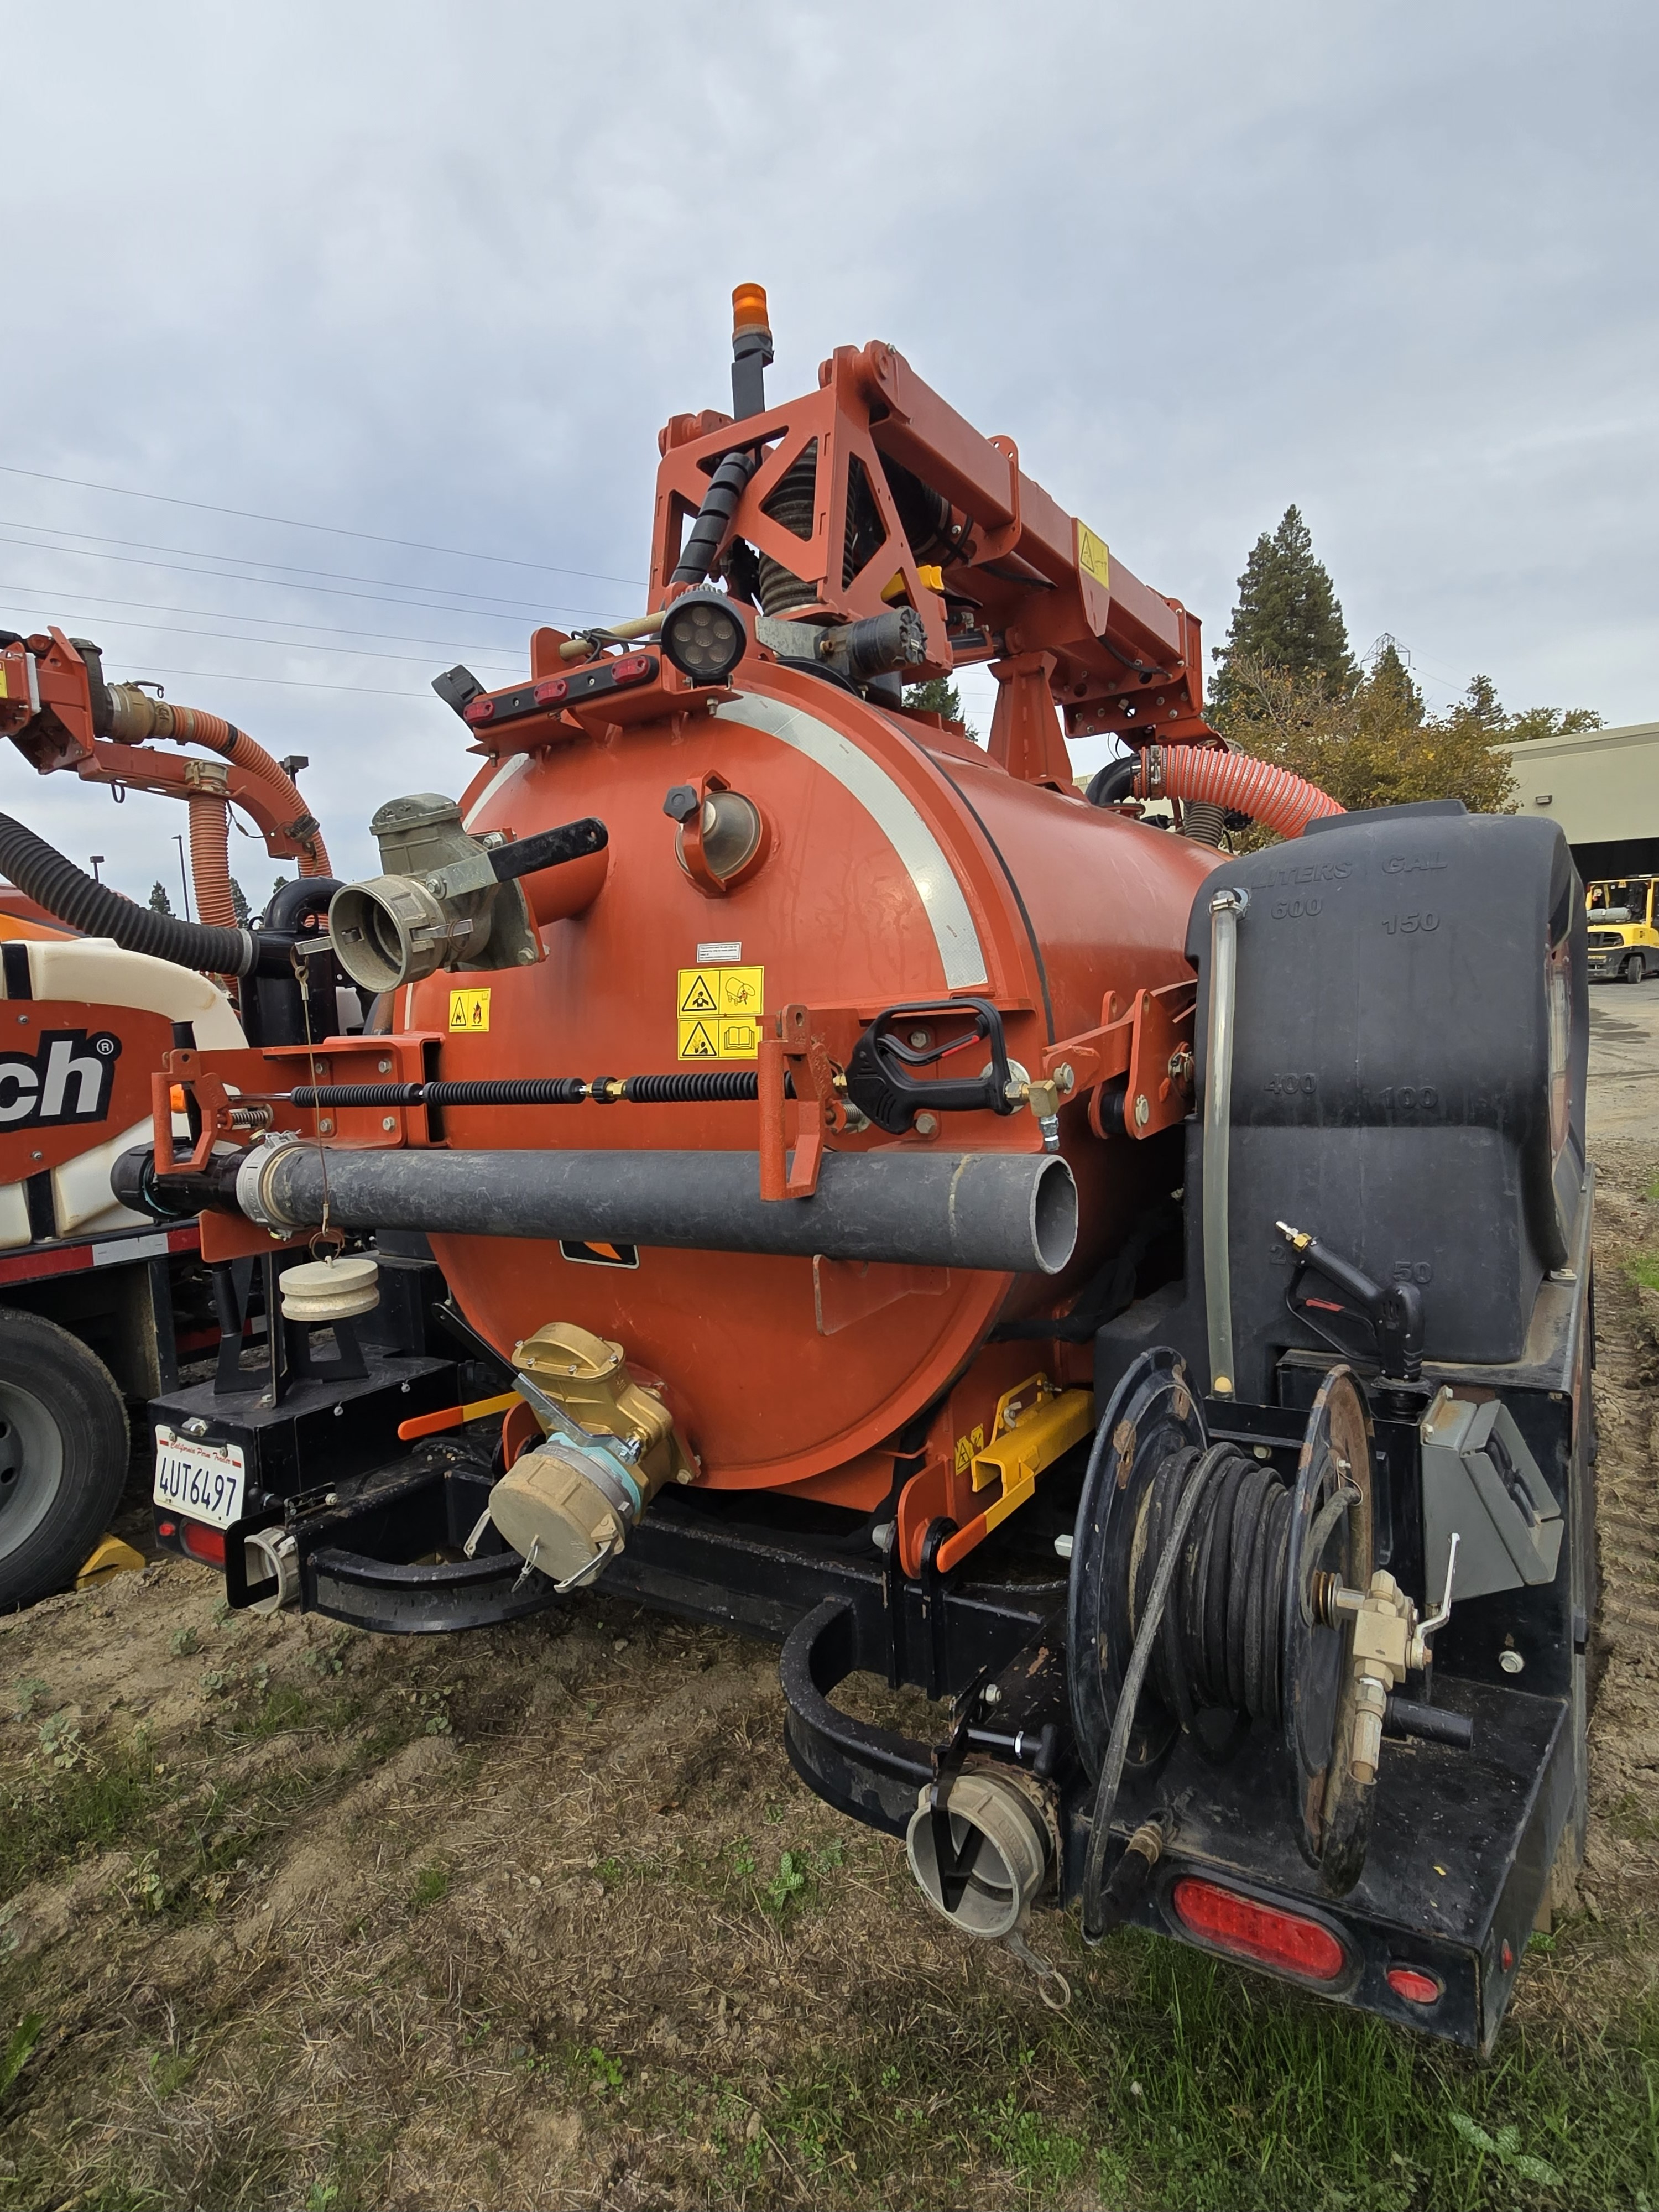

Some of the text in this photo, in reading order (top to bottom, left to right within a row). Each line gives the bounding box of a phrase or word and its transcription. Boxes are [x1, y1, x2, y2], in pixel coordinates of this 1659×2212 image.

[1251, 855, 1448, 889] LITERS GAL
[1271, 898, 1440, 935] 600 150
[1264, 1072, 1438, 1108] 400 100
[1393, 1261, 1433, 1284] 50
[170, 1442, 195, 1454] California
[197, 1447, 211, 1458] Perm
[159, 1457, 237, 1516] 4UT6497
